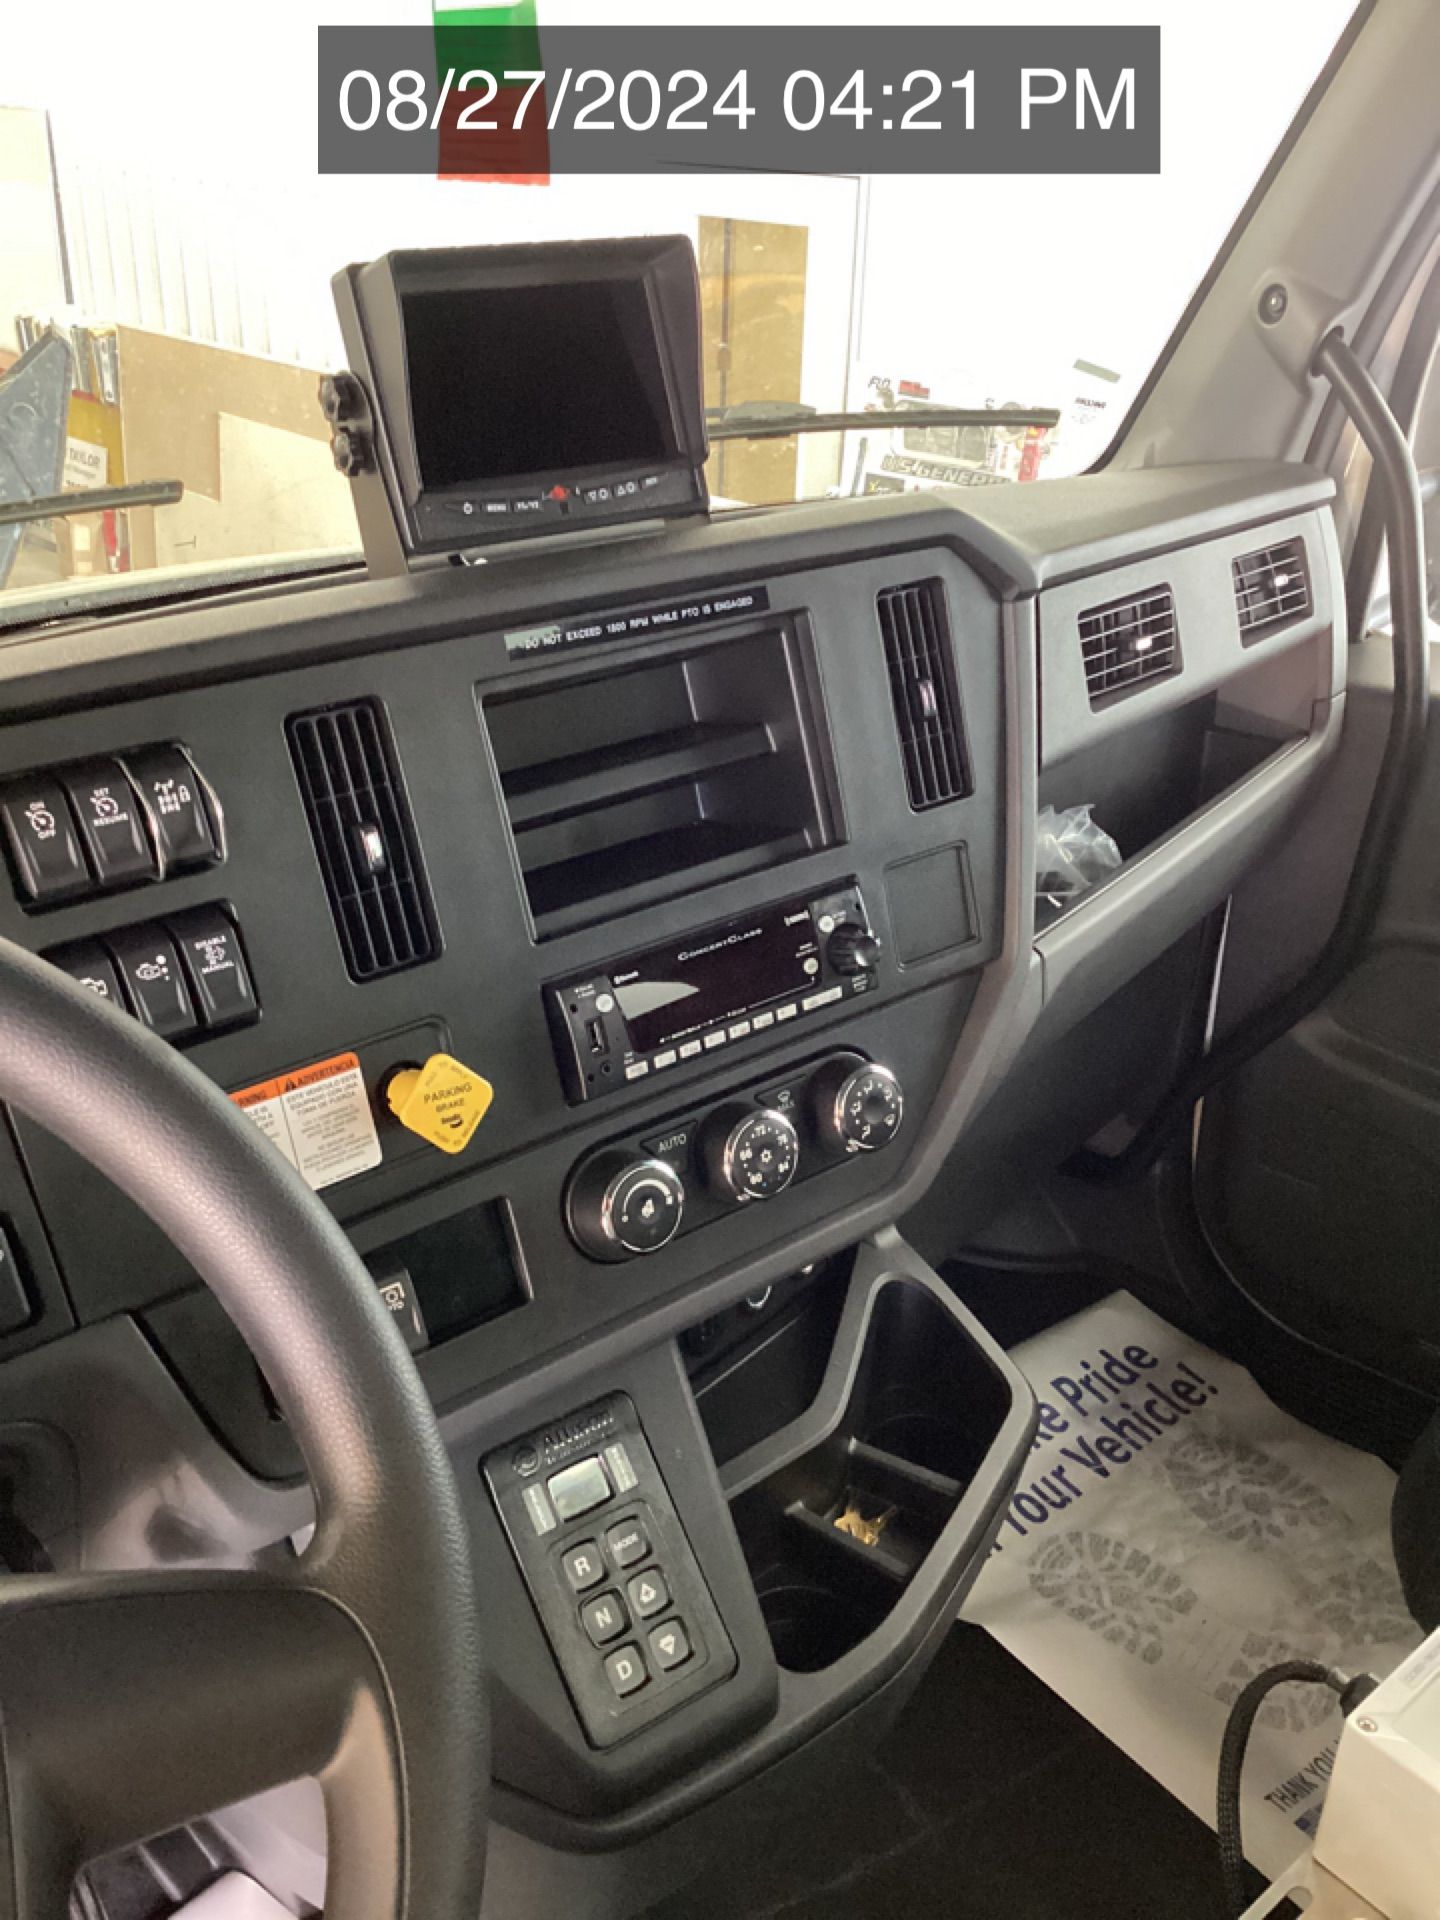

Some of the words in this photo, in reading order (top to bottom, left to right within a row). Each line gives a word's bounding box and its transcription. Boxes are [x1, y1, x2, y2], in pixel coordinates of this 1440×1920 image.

[543, 632, 561, 646] NOT
[566, 625, 603, 642] EXCEED
[630, 617, 648, 629] RPM
[652, 611, 678, 625] WHILE
[681, 606, 699, 618] PTO
[714, 595, 753, 613] ENGAGED
[424, 1082, 472, 1104] PARKING
[436, 1098, 464, 1112] BRAKE
[658, 1133, 687, 1154] AUTO
[1050, 1344, 1159, 1417] Pride
[1060, 1361, 1219, 1478] Vehicle!
[572, 1556, 592, 1577] R
[594, 1607, 613, 1628] N
[616, 1660, 633, 1680] D
[1264, 1771, 1319, 1813] THANK
